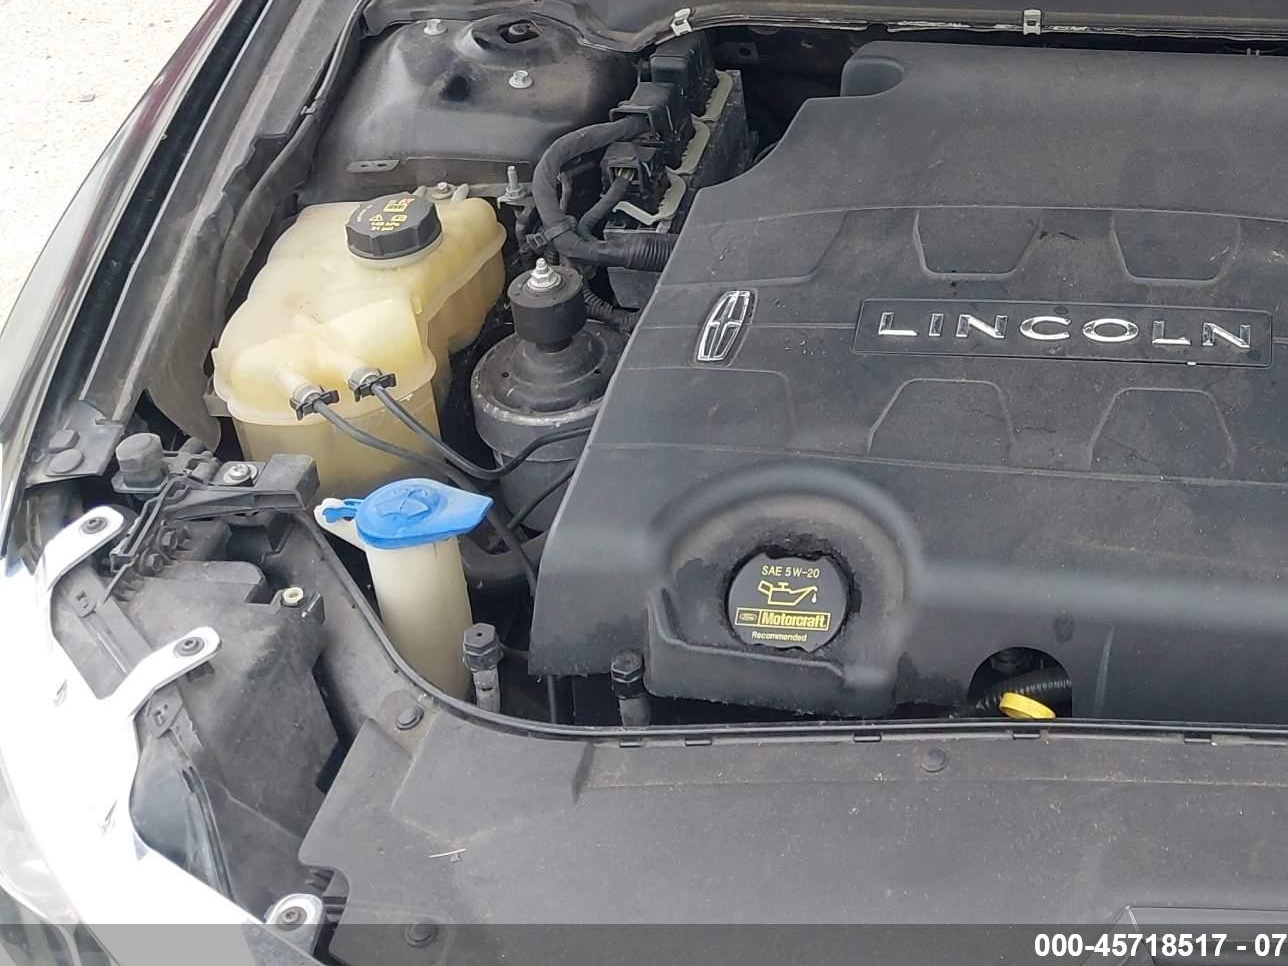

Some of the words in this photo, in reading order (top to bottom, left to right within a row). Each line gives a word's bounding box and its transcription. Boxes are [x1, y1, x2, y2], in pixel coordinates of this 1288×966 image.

[877, 312, 1250, 349] LINCOLN
[761, 565, 783, 577] SAE
[785, 567, 820, 579] 5W-20
[751, 631, 808, 642] Recommended
